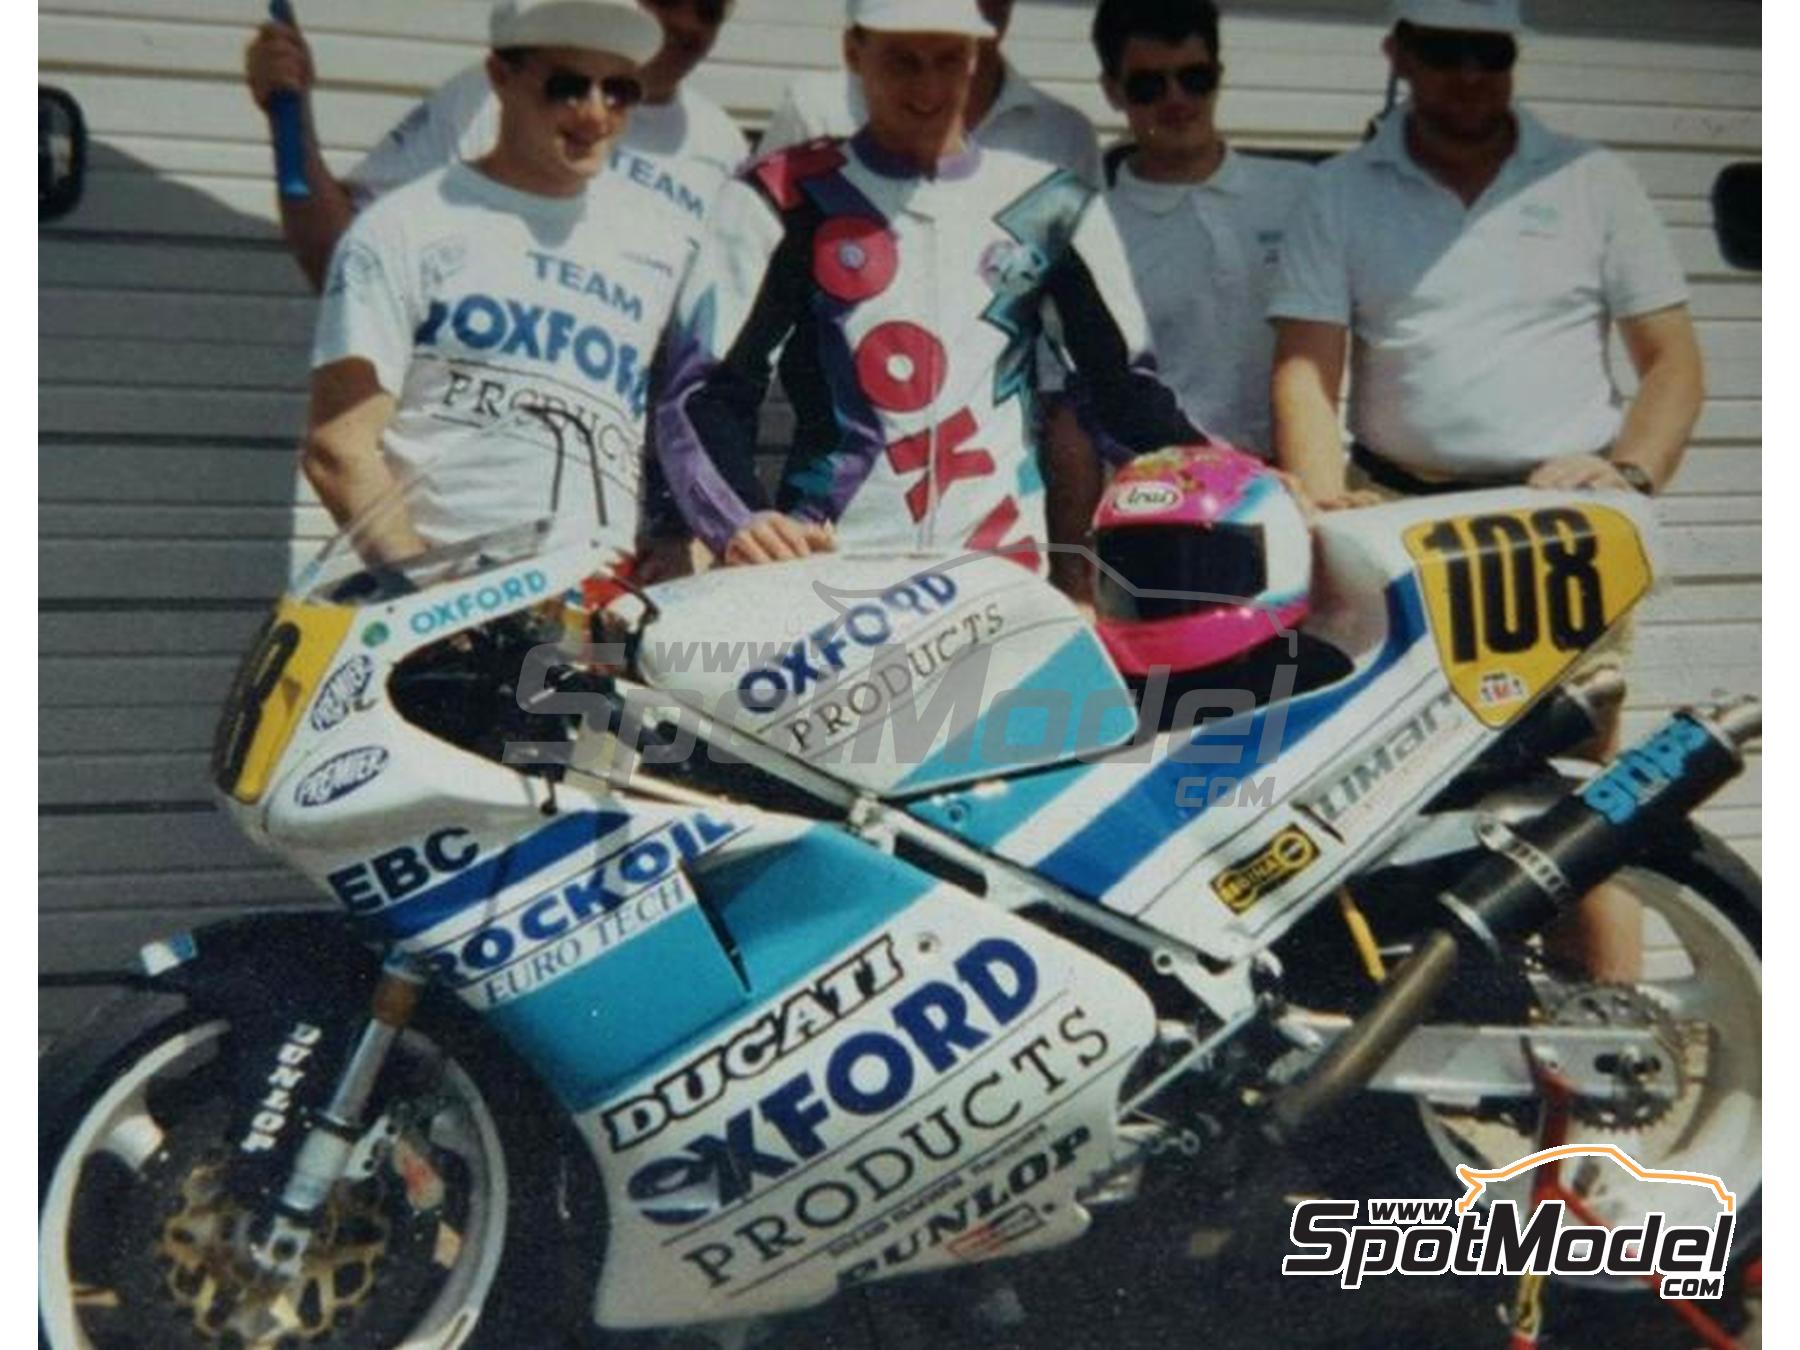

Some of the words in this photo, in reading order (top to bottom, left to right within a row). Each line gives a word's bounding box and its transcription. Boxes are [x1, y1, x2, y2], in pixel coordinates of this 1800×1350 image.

[609, 147, 704, 221] TEAM
[528, 250, 644, 320] TEAM
[409, 570, 548, 635] OXFORD
[737, 571, 957, 715] OXFORD
[1422, 504, 1606, 664] 108
[787, 604, 1005, 750] PRODUCTS
[328, 827, 480, 911] EBC
[484, 937, 583, 1002] EURO
[596, 877, 686, 948] TECH
[601, 932, 904, 1153] DUCATI
[627, 936, 1039, 1225] OXFORD
[683, 1006, 1109, 1288] PRODUCTS
